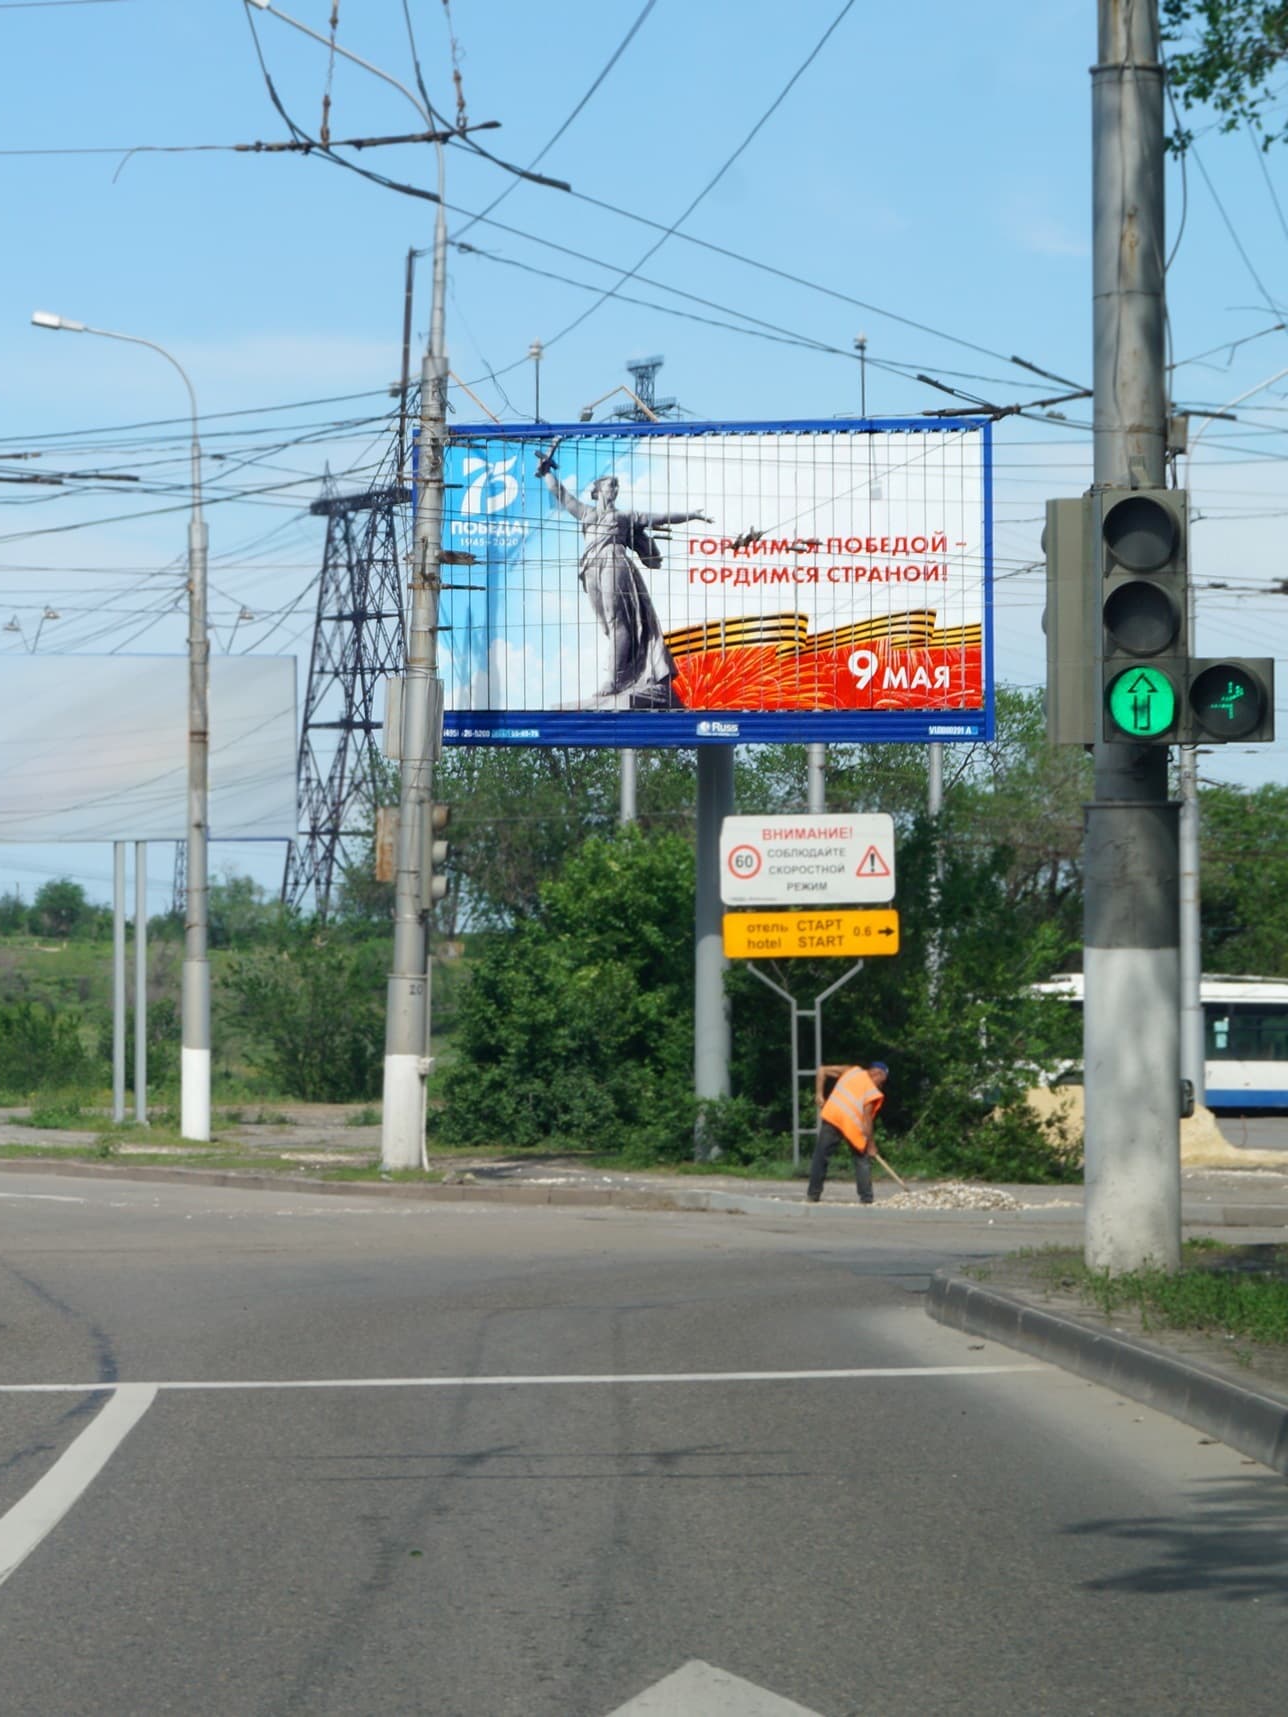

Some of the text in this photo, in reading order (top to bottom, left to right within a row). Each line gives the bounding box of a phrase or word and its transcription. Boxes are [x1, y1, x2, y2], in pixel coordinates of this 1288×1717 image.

[688, 537, 818, 559] ГОРДИМСЯ
[826, 531, 948, 556] ПОБЕДОЙ
[688, 560, 949, 587] ГОРДИМСЯ СТРАНОЙ!
[848, 649, 950, 690] 9 МАЯ
[761, 827, 854, 841] ВНИМАНИЕ!
[767, 847, 847, 859] СОБЛЮДАЙТЕ
[735, 854, 754, 869] 60
[768, 863, 846, 875] СКОРОСТНОЙ
[786, 882, 828, 892] РЕЖИМ
[747, 919, 843, 933] отель СТАРТ
[747, 935, 845, 950] hotel START
